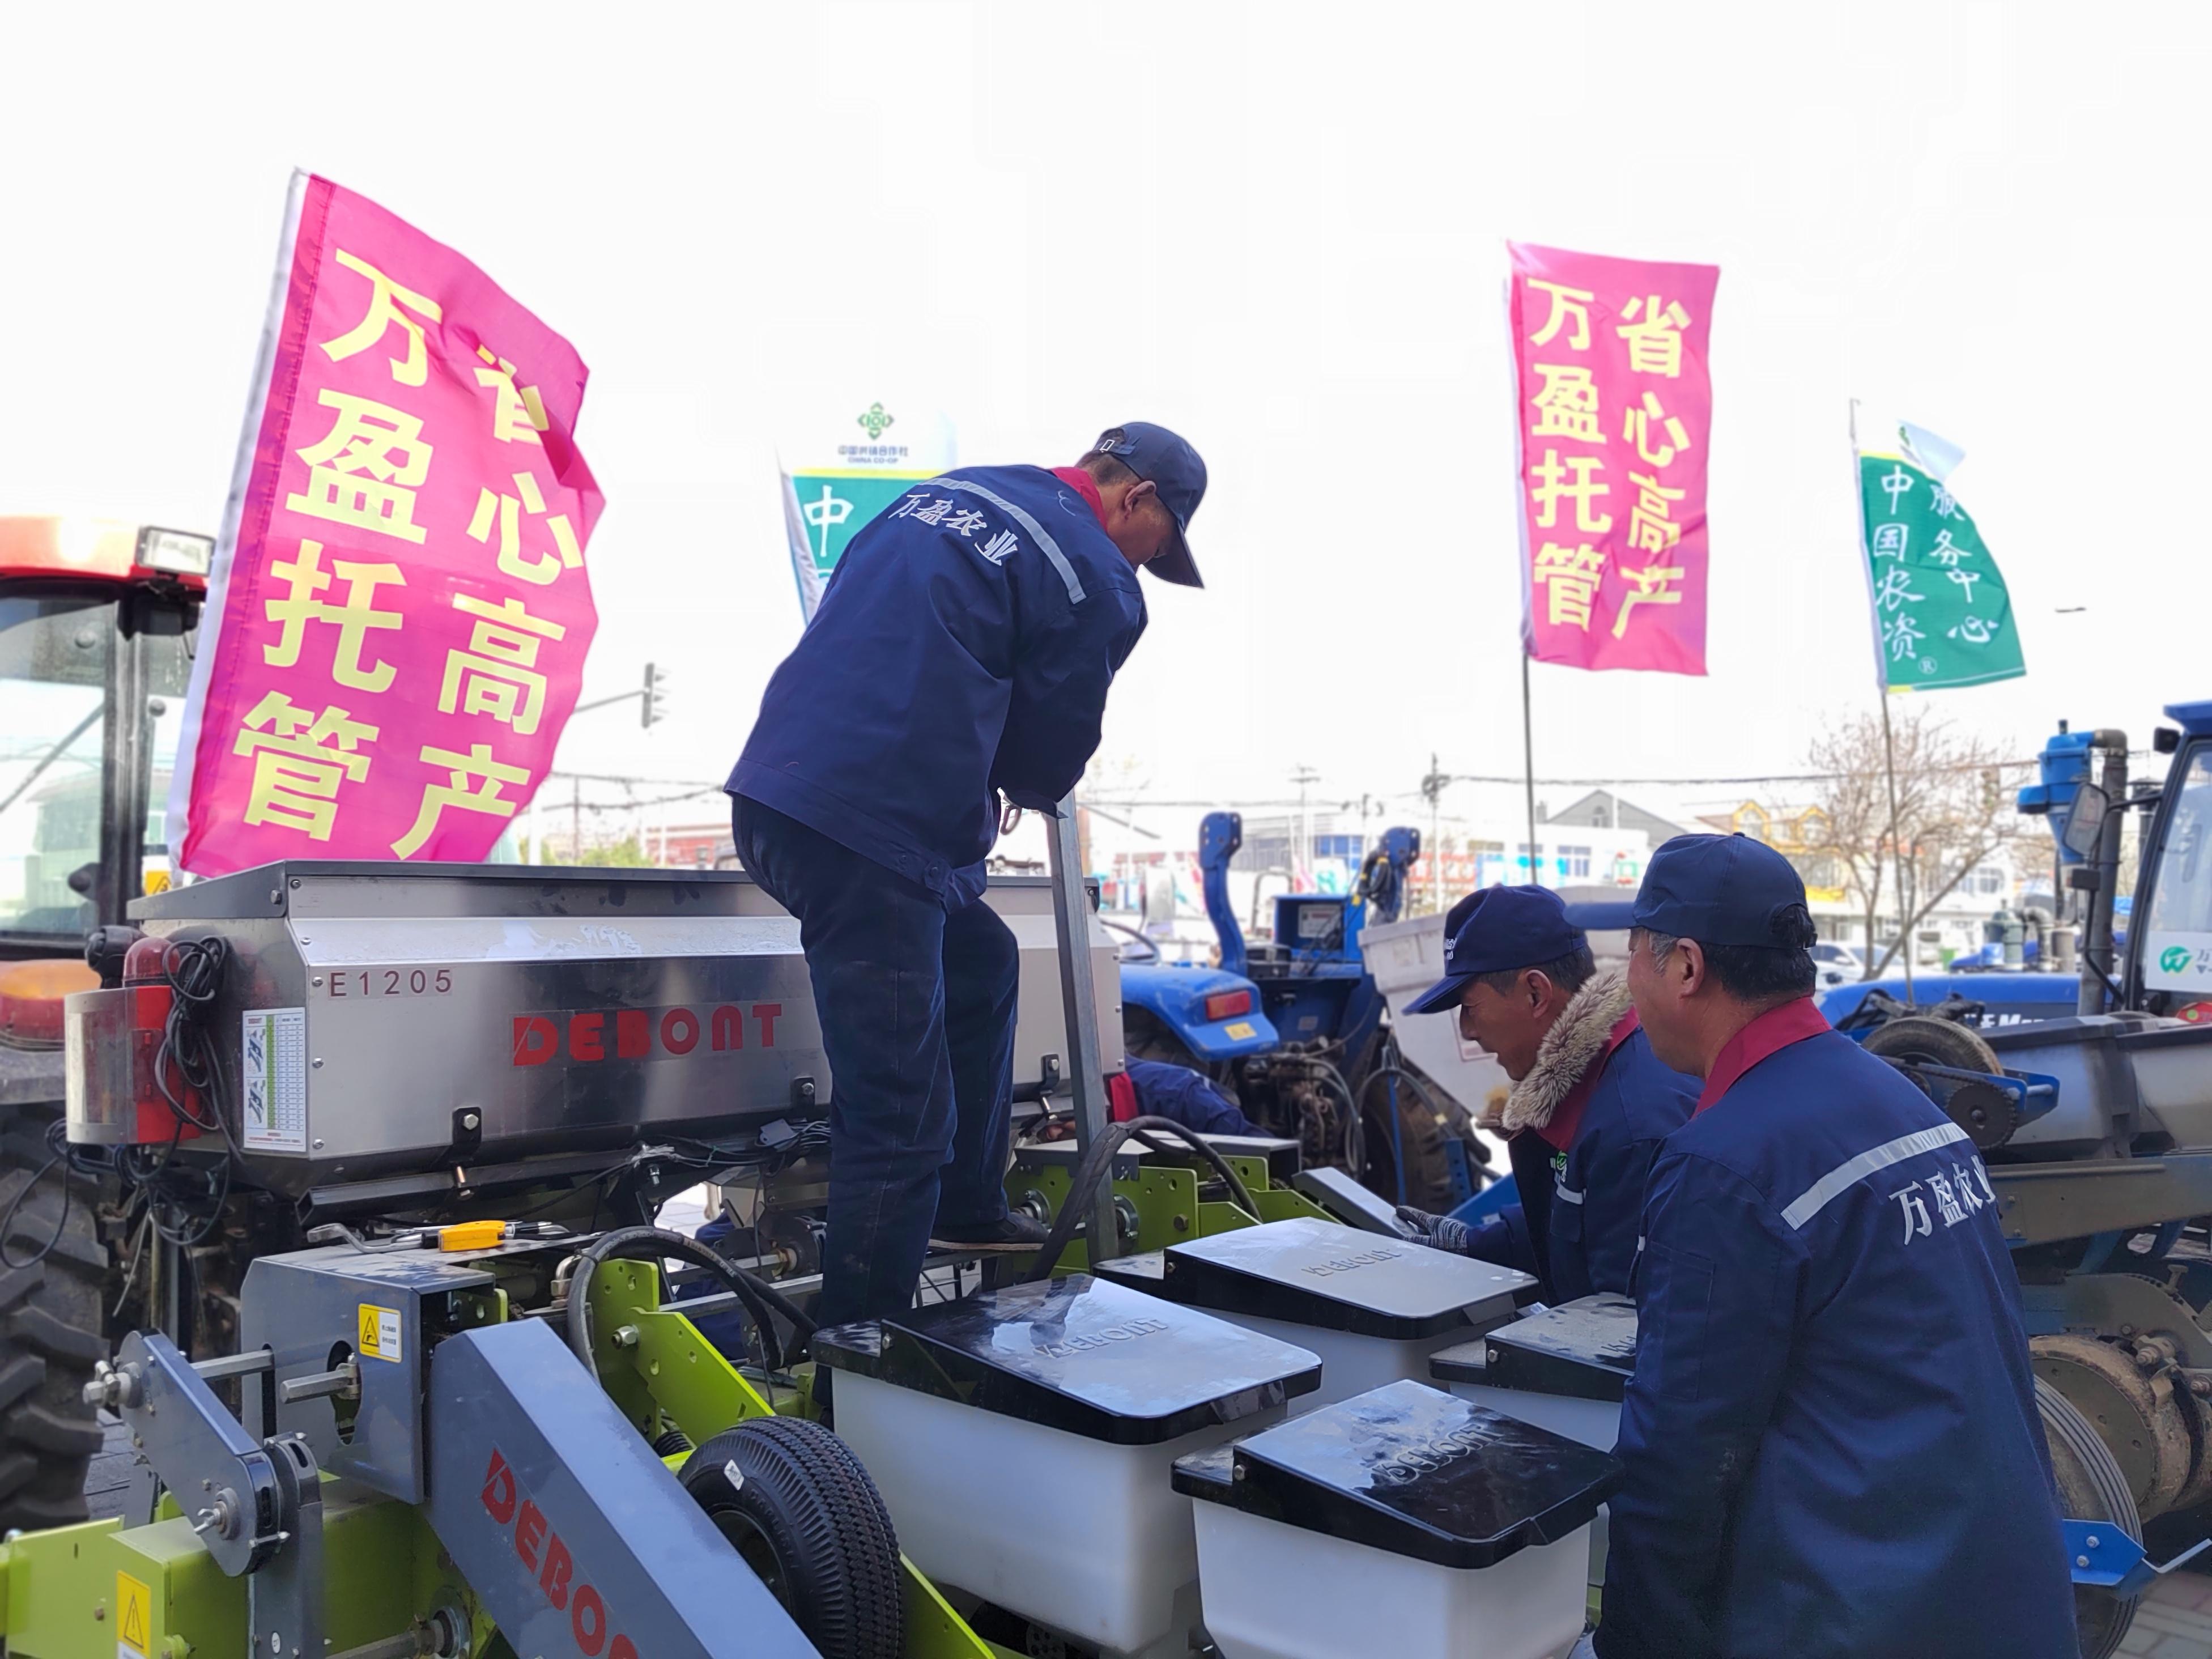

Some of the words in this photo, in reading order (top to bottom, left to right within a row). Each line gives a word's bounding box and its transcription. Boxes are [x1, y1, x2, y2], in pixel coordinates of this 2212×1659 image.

[232, 248, 443, 842] 万盈托管
[803, 485, 854, 580] 中
[1526, 278, 1613, 632] 万盈托管
[1611, 295, 1692, 640] 省心高产
[1873, 465, 1926, 662] 中国农资
[330, 969, 452, 997] E1205
[513, 1003, 782, 1066] DEBONT
